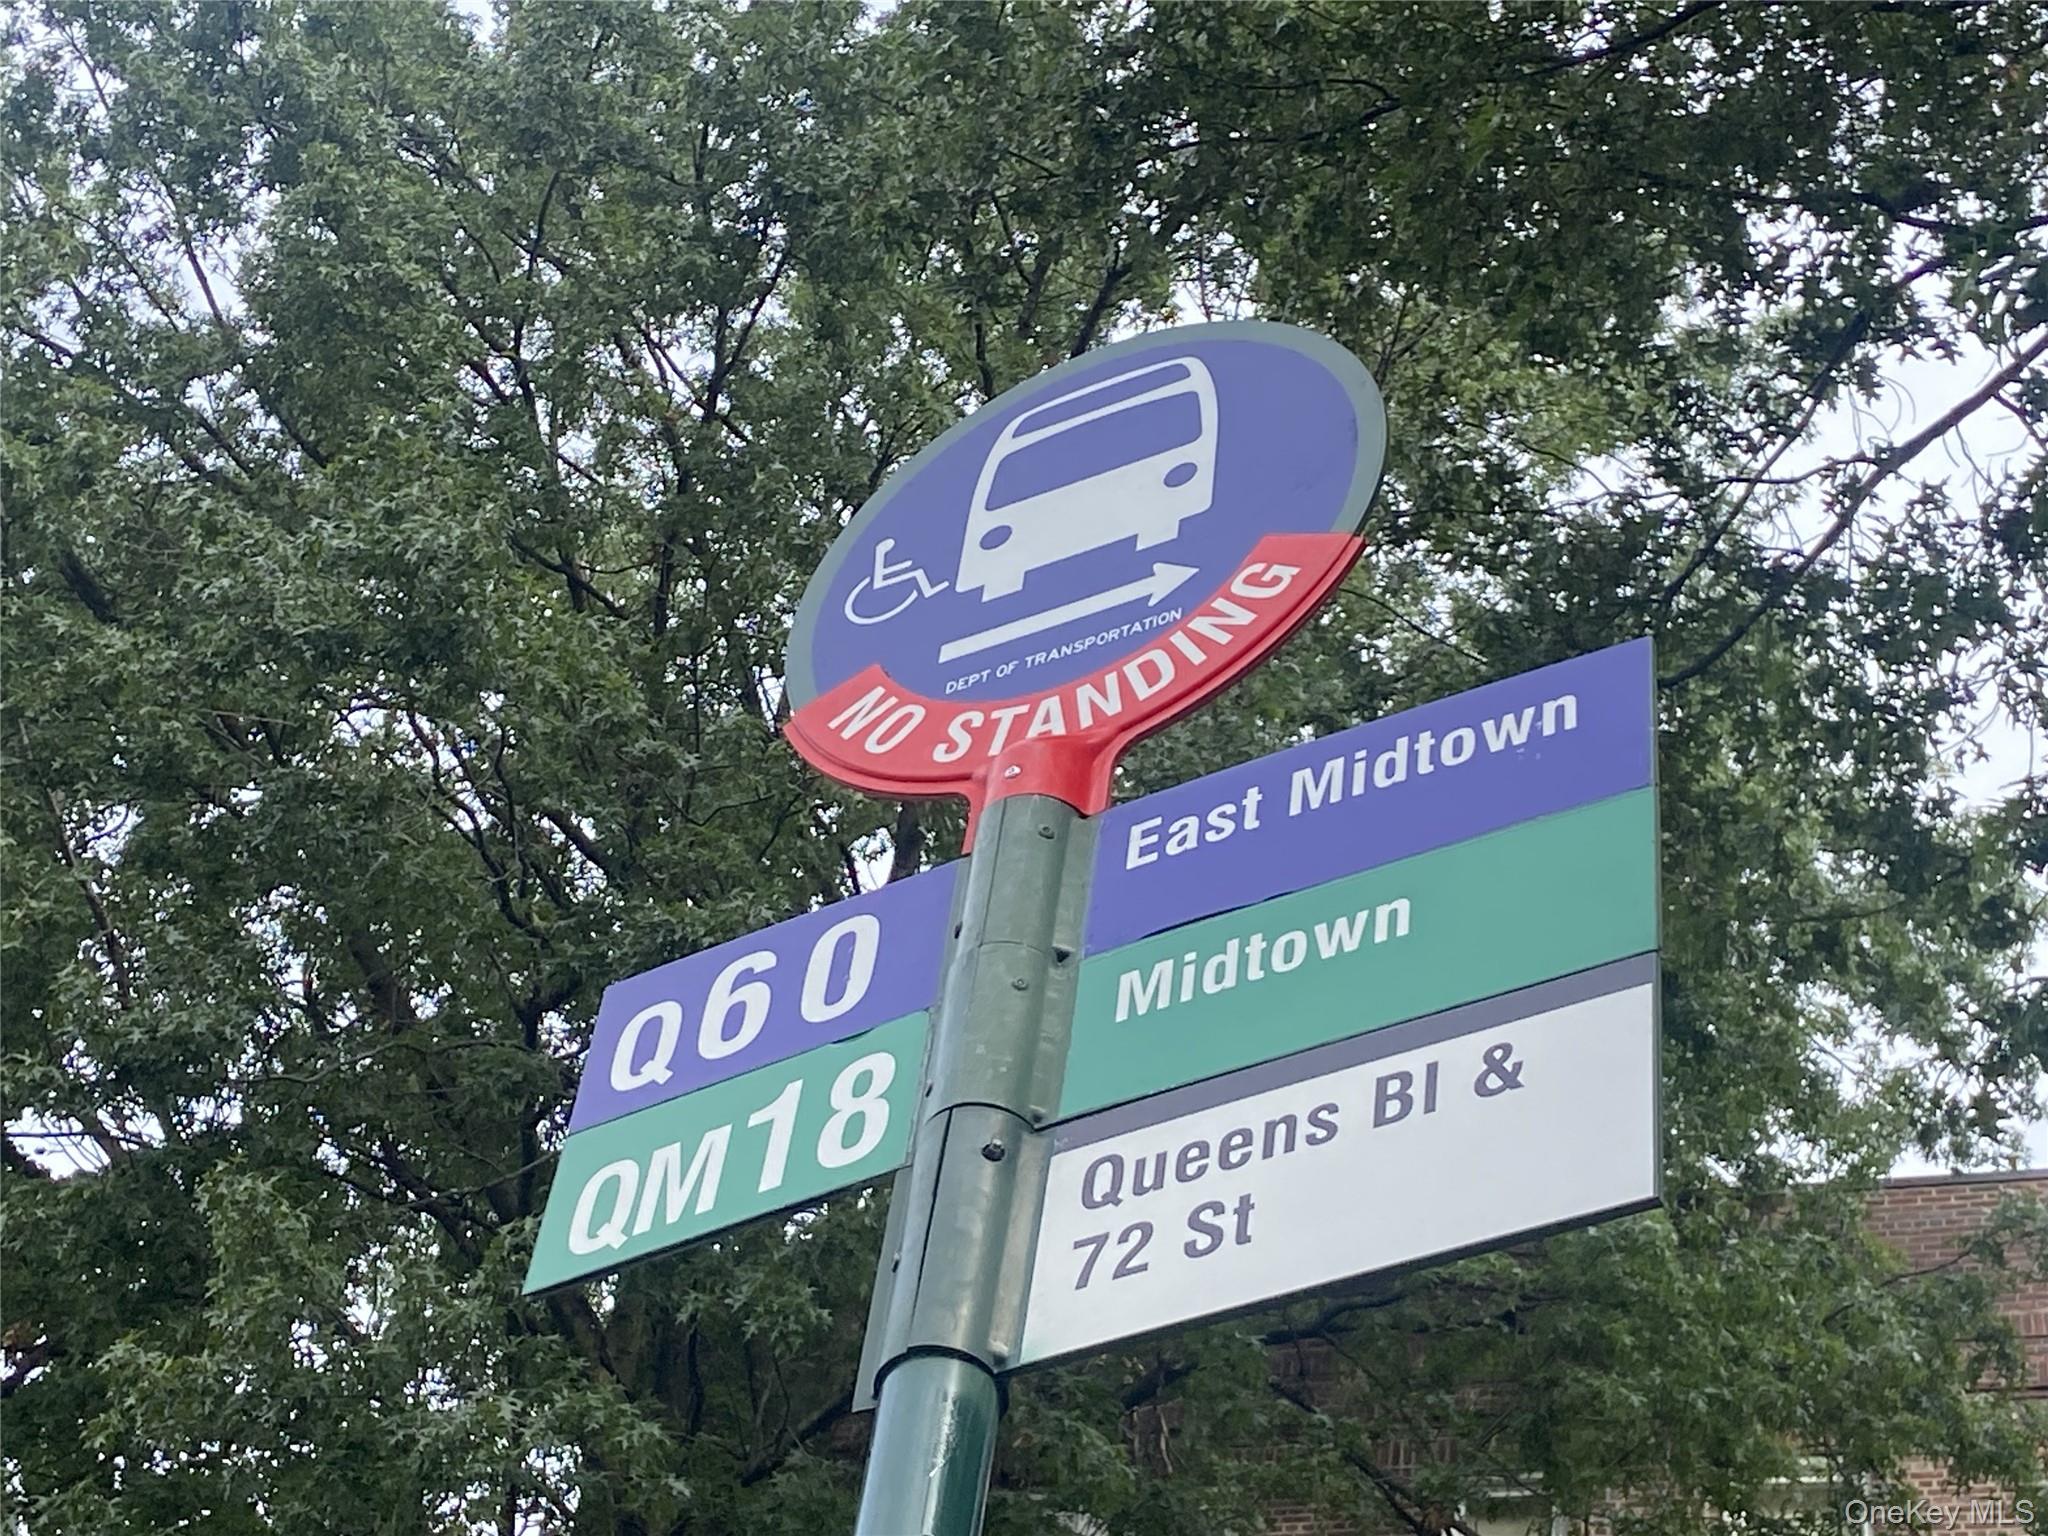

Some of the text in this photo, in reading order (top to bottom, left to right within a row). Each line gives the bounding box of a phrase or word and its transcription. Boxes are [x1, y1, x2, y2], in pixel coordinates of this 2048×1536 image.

[828, 562, 1301, 763] NO STANDING
[945, 607, 1183, 695] DEPT OF TRANSPORTATION
[1124, 692, 1579, 871] East Midtown
[609, 914, 881, 1092] Q60
[1114, 897, 1413, 1024] Midtown
[567, 1052, 897, 1256] QM18
[1081, 1042, 1525, 1210] Queens Bl &
[1072, 1193, 1256, 1291] 72 St
